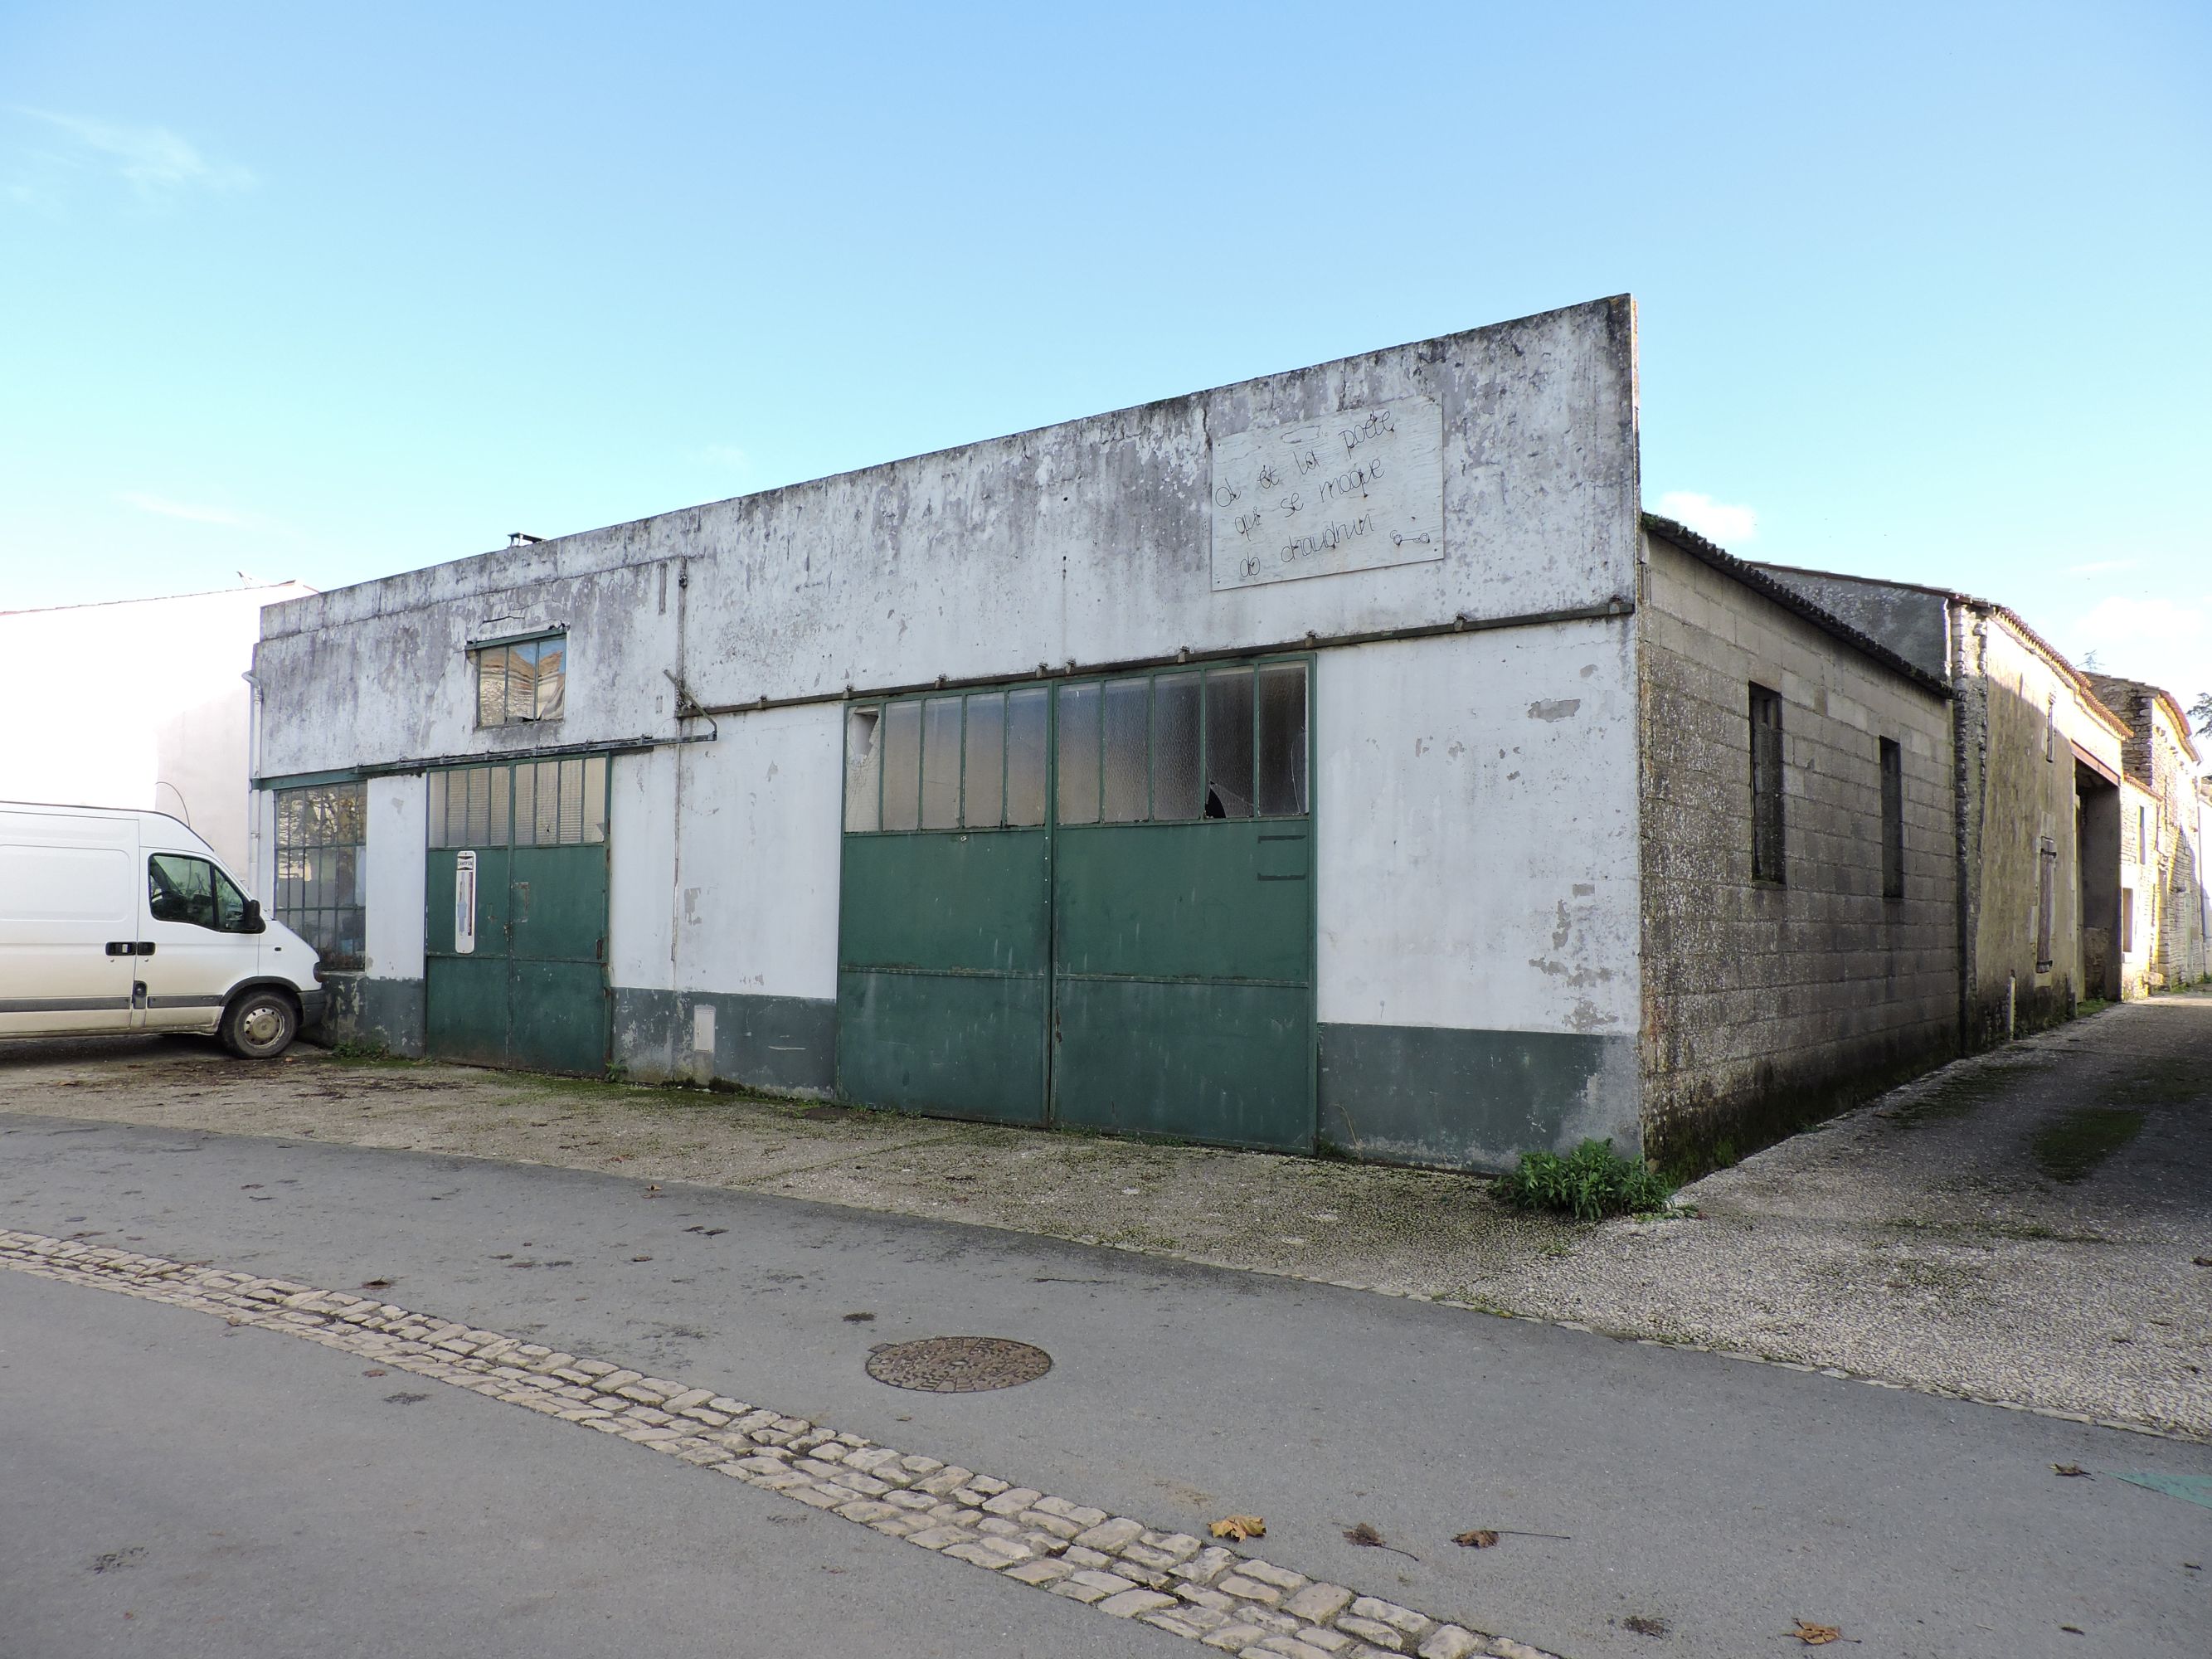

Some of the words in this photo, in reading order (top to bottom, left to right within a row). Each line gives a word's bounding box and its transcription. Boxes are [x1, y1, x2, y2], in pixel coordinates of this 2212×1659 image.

[1293, 450, 1320, 474] la
[1234, 506, 1262, 542] qui
[1281, 492, 1304, 518] se
[1319, 459, 1385, 503] moque
[1239, 552, 1261, 577] do
